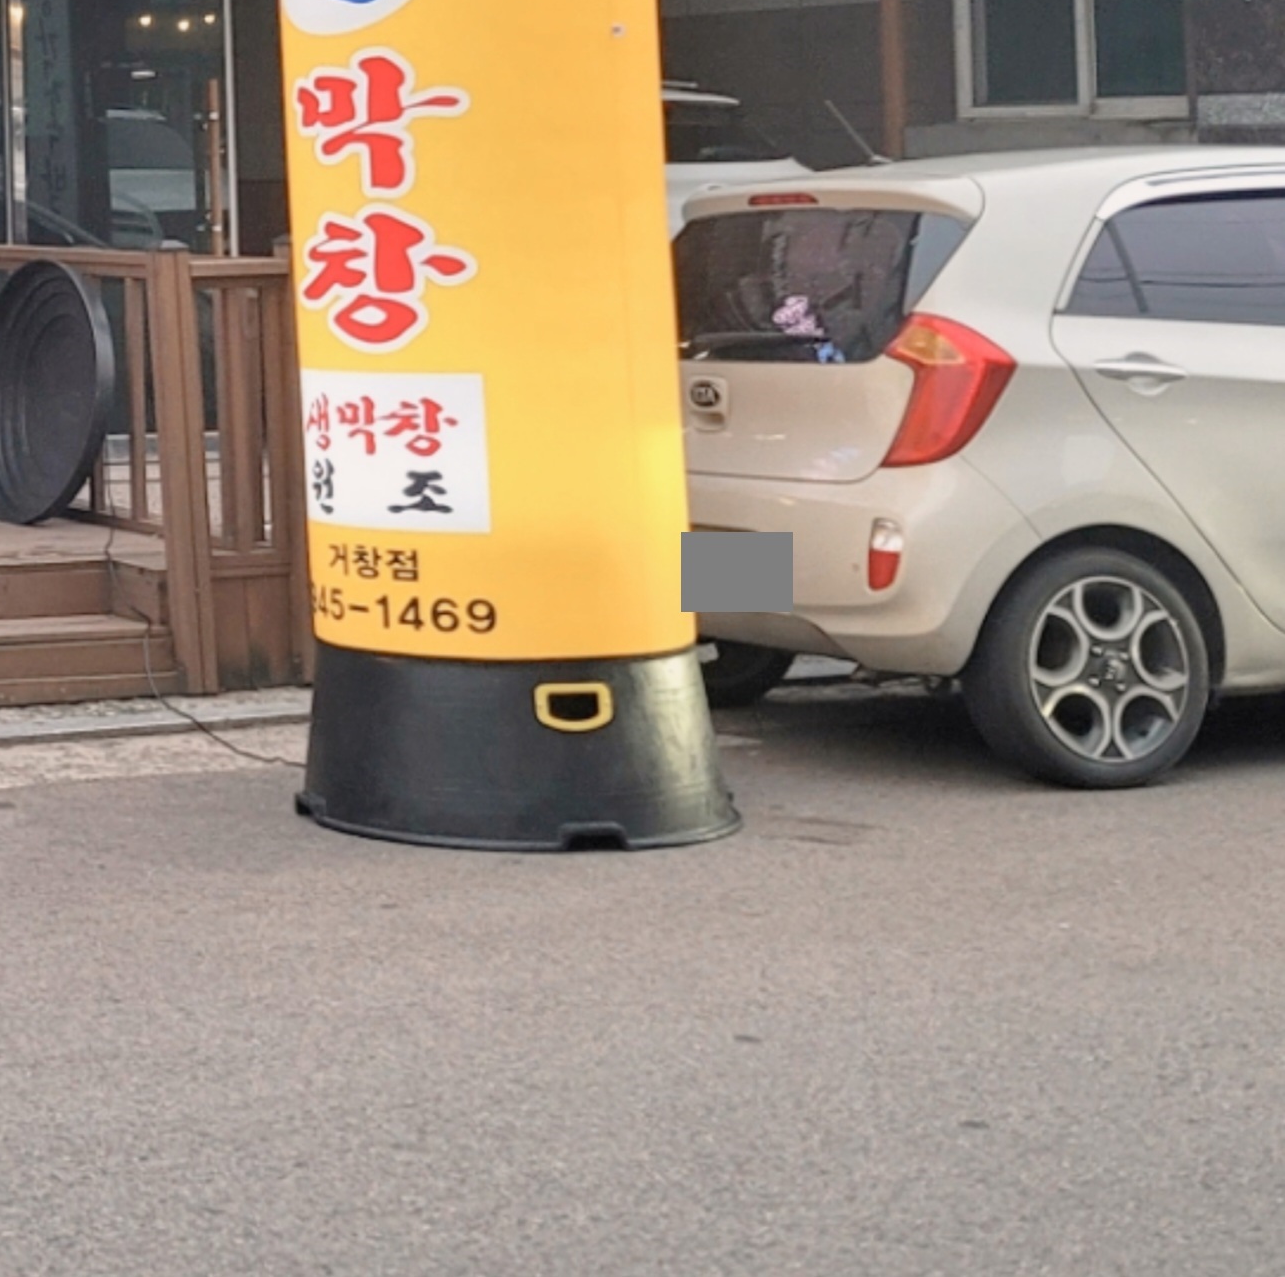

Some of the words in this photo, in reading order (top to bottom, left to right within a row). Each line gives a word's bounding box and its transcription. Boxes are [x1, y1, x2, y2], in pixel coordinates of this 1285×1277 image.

[306, 392, 459, 456] 생막창
[387, 470, 454, 514] 조
[328, 543, 420, 582] 거창점
